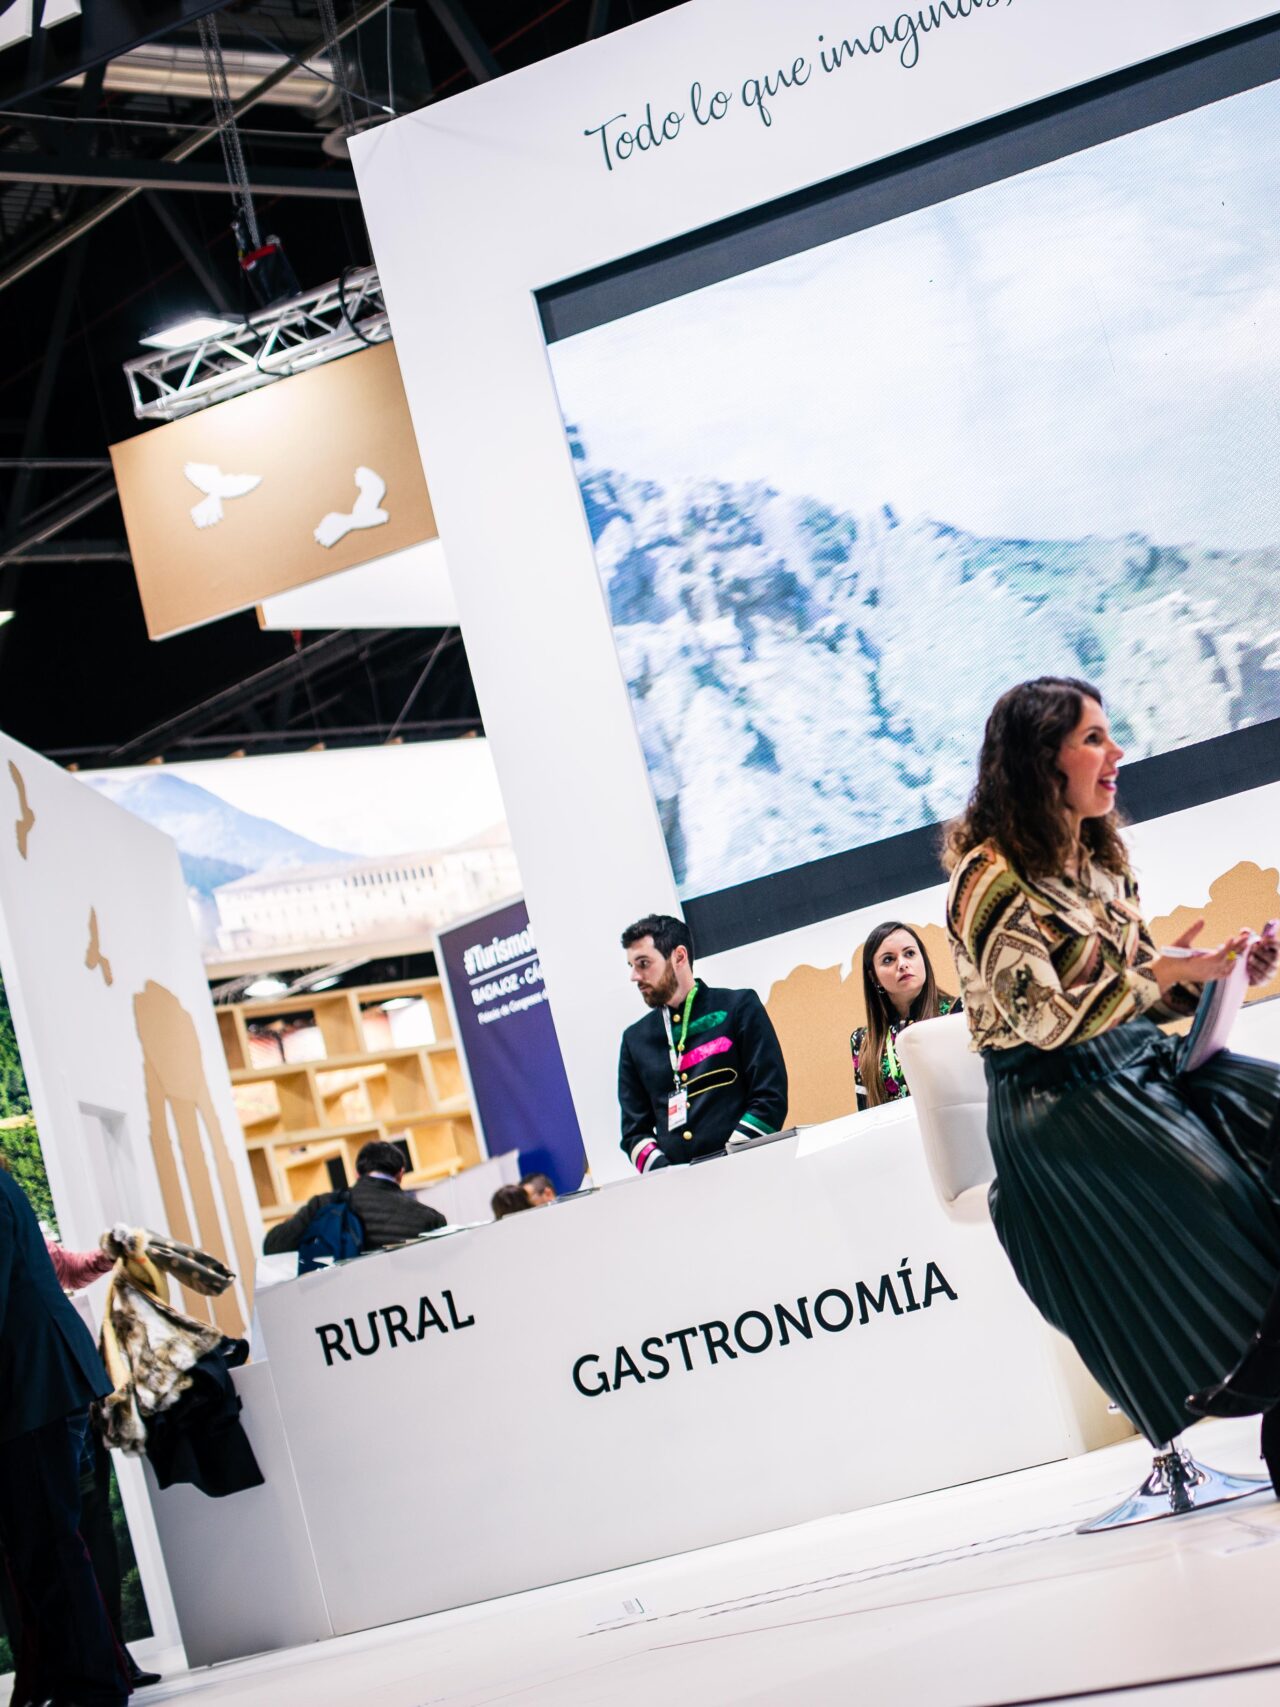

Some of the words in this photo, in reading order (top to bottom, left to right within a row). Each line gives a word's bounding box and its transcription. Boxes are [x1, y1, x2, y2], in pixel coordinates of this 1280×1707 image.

[584, 104, 685, 170] Todo
[690, 82, 733, 126] lo
[741, 57, 811, 127] que
[314, 1289, 476, 1367] RURAL
[572, 1256, 959, 1397] GASTRONOMÍA
